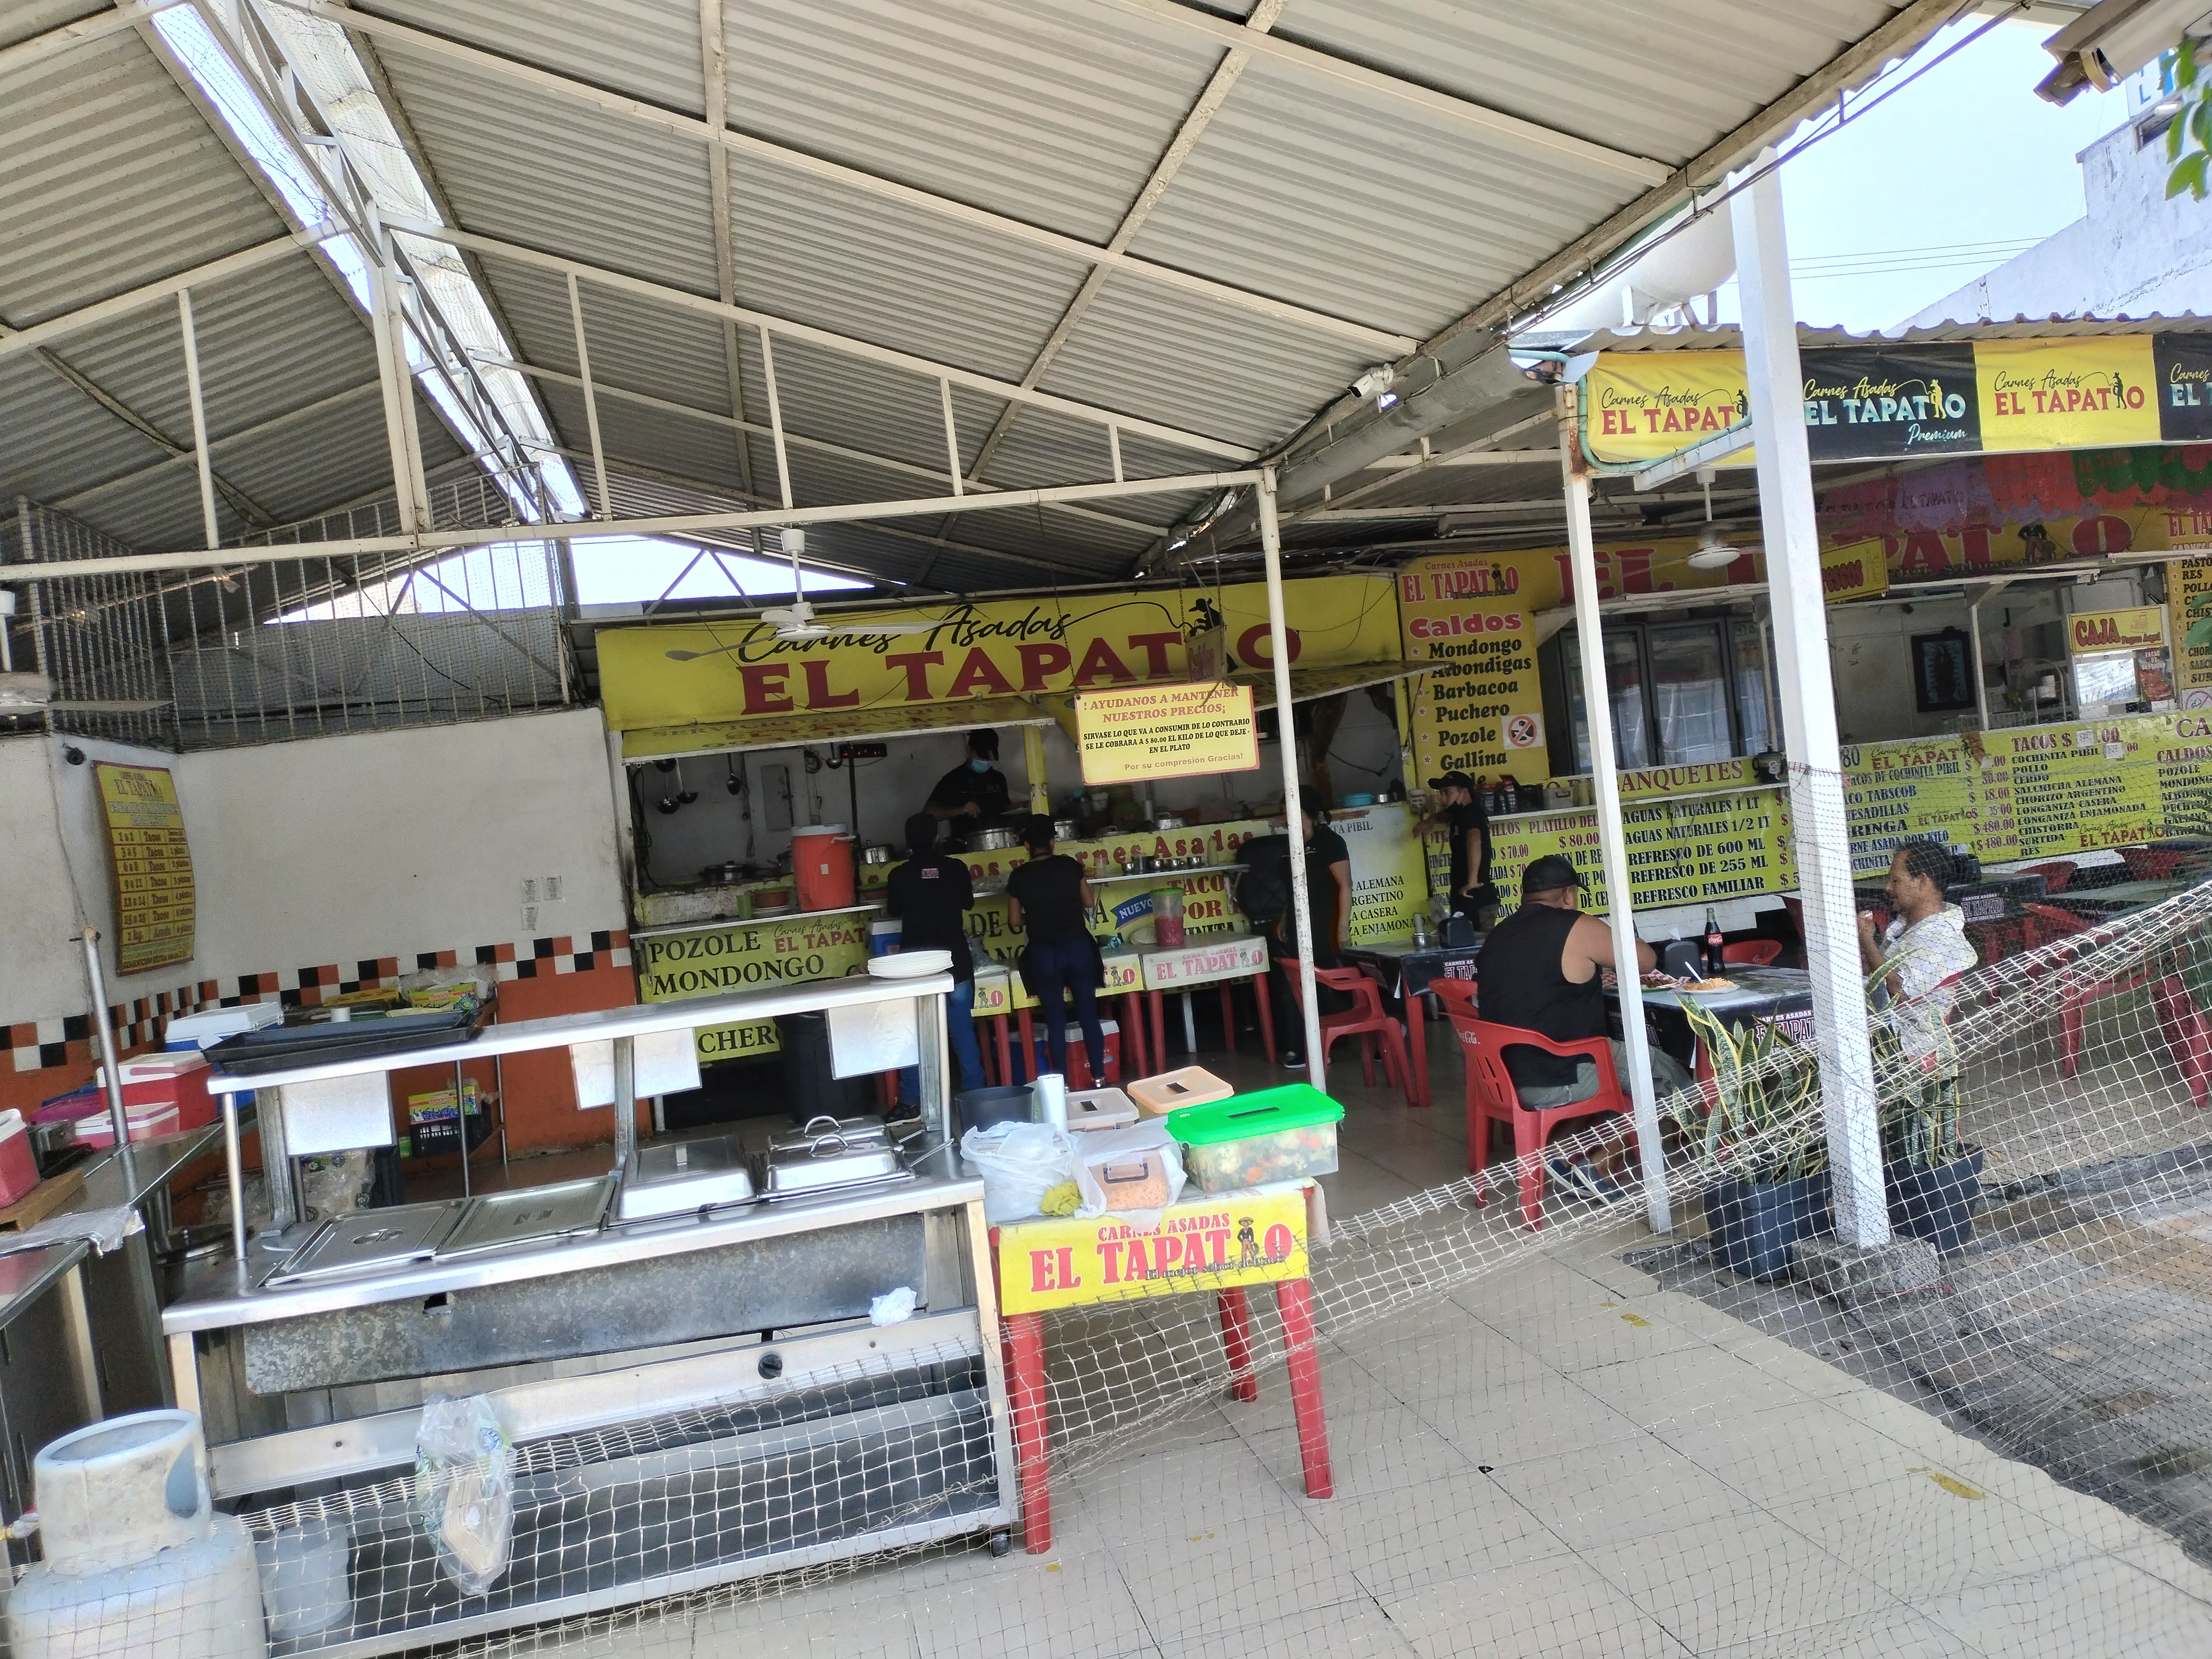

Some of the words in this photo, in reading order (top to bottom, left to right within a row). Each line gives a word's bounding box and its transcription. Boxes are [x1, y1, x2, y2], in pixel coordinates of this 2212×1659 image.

[1994, 371, 2036, 392] Carnes
[2041, 369, 2082, 390] Asadas
[2171, 363, 2210, 383] Carnes
[1602, 387, 1648, 409] Carnes
[1654, 386, 1703, 407] Asadas
[1804, 378, 1848, 399] Carnes
[1852, 376, 1899, 399] Asadas
[2171, 383, 2200, 407] EL
[1804, 400, 1838, 426] EL
[1995, 392, 2026, 416] EL
[1602, 408, 1636, 436] EL
[1907, 424, 1967, 445] Premium
[1425, 561, 1455, 571] Carnes
[1457, 558, 1488, 568] Asadas
[2182, 570, 2203, 579] RES
[1402, 575, 1426, 602] EL
[926, 604, 1072, 651] Asadas
[1409, 613, 1522, 638] Caldos
[2075, 617, 2121, 646] CAJA
[1429, 639, 1522, 659] Mondongo
[737, 660, 859, 715] EL
[1433, 679, 1519, 701] Barbacoa
[1090, 696, 1156, 710] AYUDANOS
[1159, 695, 1168, 703] A
[1171, 688, 1239, 703] MANTENER
[1103, 709, 1167, 723] NUESTROS
[1435, 702, 1510, 723] Puchero
[1083, 731, 1112, 740] SIRVASE
[1113, 729, 1122, 738] LO
[1124, 728, 1138, 738] QUE
[1155, 723, 1190, 734] CONSUMIR
[1212, 718, 1250, 728] CONTRARIO
[1438, 727, 1497, 747] Pozole
[1096, 741, 1104, 749] LE
[1105, 738, 1138, 748] COBRARA
[1145, 737, 1150, 745] $
[1178, 733, 1193, 742] KILO
[1215, 730, 1229, 738] QUE
[1169, 744, 1191, 752] PLATO
[2011, 733, 2058, 752] TACOS
[2061, 732, 2072, 748] $
[1155, 756, 1205, 769] compresión
[1208, 752, 1244, 762] Gracias!
[1440, 750, 1507, 771] Gallina
[1871, 756, 1895, 771] EL
[2011, 751, 2067, 764] COCHINITA
[2070, 747, 2101, 758] PIBIL
[1875, 770, 1886, 783] DE
[1889, 765, 1934, 781] COCHINITA
[1936, 762, 1961, 775] PIBIL
[1965, 759, 1972, 772] $
[2012, 763, 2048, 775] POLLO
[2158, 765, 2201, 777] POZOLE
[2013, 774, 2050, 785] CERDO
[2014, 781, 2072, 795] SALCHICHA
[2075, 776, 2122, 788] ALEMANA
[2015, 792, 2064, 805] CHORIZO
[2066, 785, 2126, 799] ARGENTINO
[1622, 808, 1662, 824] AGUAS
[1736, 798, 1742, 811] 1
[1746, 797, 1760, 809] LT
[1845, 802, 1910, 821] UESADILLAS
[2016, 801, 2076, 815] LONGANIZA
[2078, 796, 2117, 808] CASERA
[2017, 811, 2076, 826] LONGANIZA
[2080, 803, 2147, 818] ENJAMONADA
[1347, 821, 1373, 833] PIBIL
[1528, 816, 1576, 834] PLATILLO
[1579, 814, 1599, 828] DEL
[1625, 829, 1663, 845] AGUAS
[1666, 820, 1729, 840] NATURALES
[1732, 818, 1754, 832] 1/2
[1758, 816, 1770, 828] LT
[1781, 813, 1788, 826] $
[2018, 821, 2080, 836] CHISTORRA
[1559, 835, 1566, 849] $
[1569, 832, 1600, 847] 80.00
[2019, 833, 2065, 846] SURTIDA
[2080, 834, 2098, 847] EL
[1500, 846, 1506, 861] $
[1507, 844, 1529, 859] 70.00
[1575, 850, 1587, 866] DE
[1628, 846, 1692, 866] REFRESCO
[1697, 844, 1714, 857] DE
[1718, 841, 1743, 854] 600
[1748, 838, 1765, 850] ML
[1777, 835, 1785, 848] $
[2020, 846, 2041, 856] RES
[1630, 865, 1694, 884] REFRESCO
[1699, 861, 1716, 874] DE
[1720, 859, 1746, 873] 255
[1751, 856, 1769, 868] ML
[1780, 852, 1788, 865] $
[1357, 876, 1404, 891] ALEMANA
[1633, 885, 1698, 905] REFRESCO
[1703, 877, 1764, 897] FAMILIAR
[1780, 873, 1789, 887] $
[1580, 892, 1593, 909] DE
[1360, 906, 1398, 920] CASERA
[774, 924, 805, 937] Carnes
[810, 920, 843, 933] Asadas
[968, 911, 1000, 939] DE
[649, 931, 761, 963] POZOLE
[774, 936, 799, 953] EL
[653, 955, 824, 996] MONDONGO
[1156, 962, 1177, 980] EL
[1786, 1010, 1811, 1019] ASADAS
[1167, 1213, 1230, 1234] ASADAS
[1030, 1247, 1082, 1293] EL
[1146, 1269, 1159, 1280] El
[1162, 1265, 1198, 1279] mejor
